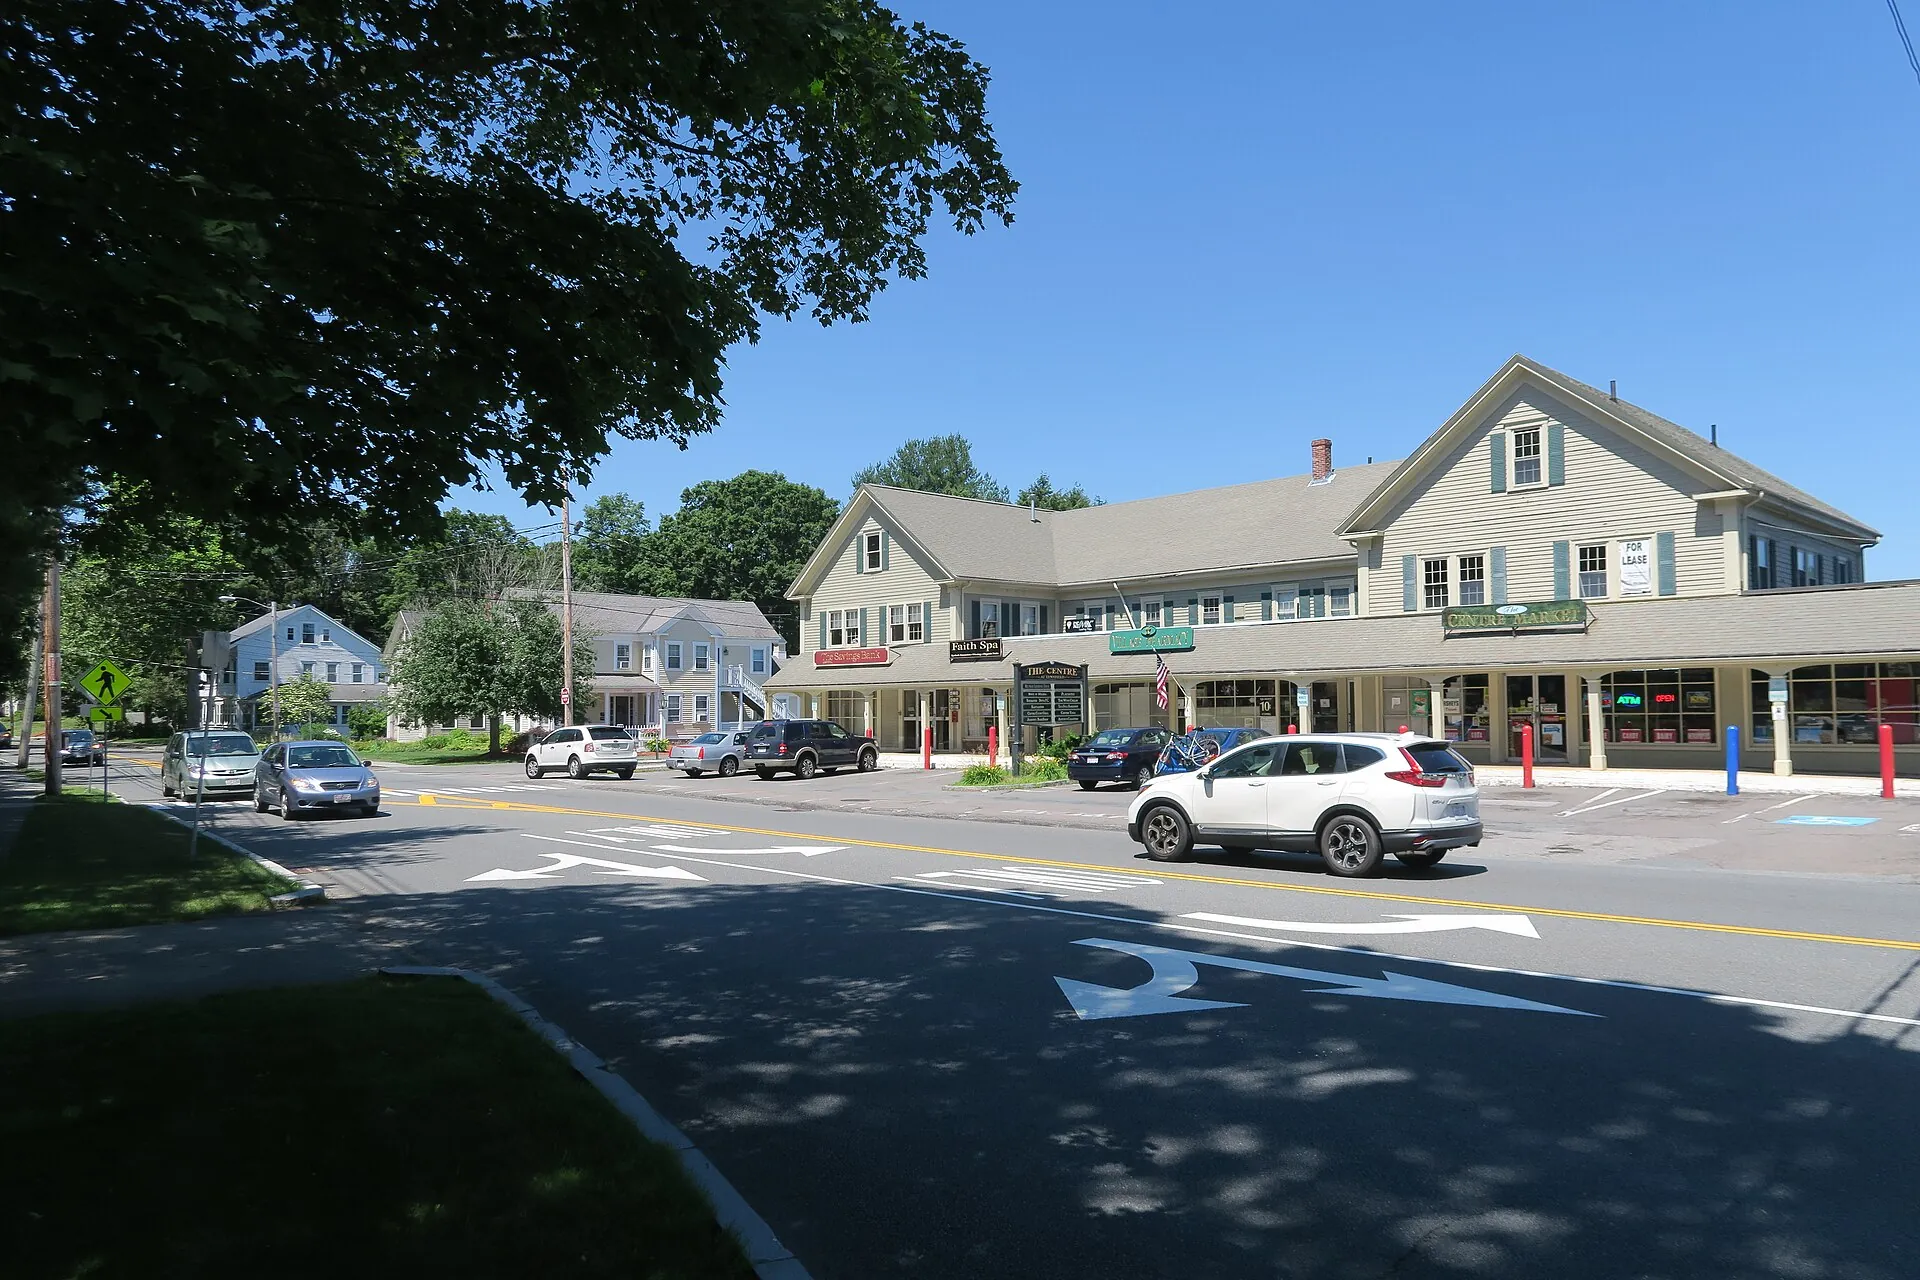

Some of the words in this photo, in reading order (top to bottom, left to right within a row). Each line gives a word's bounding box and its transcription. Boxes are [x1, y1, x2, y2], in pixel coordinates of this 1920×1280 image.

[1626, 542, 1642, 551] FOR
[1622, 555, 1647, 565] LEASE
[1447, 613, 1507, 627] CENTRE
[1513, 609, 1579, 625] MARKET
[952, 641, 977, 651] Faith
[980, 640, 998, 651] Spa
[833, 651, 861, 662] Savings
[861, 649, 880, 660] Bank
[1027, 667, 1045, 676] THE
[1046, 667, 1078, 676] CENTRE
[1616, 696, 1641, 705] ATM
[1655, 694, 1675, 702] OPEN
